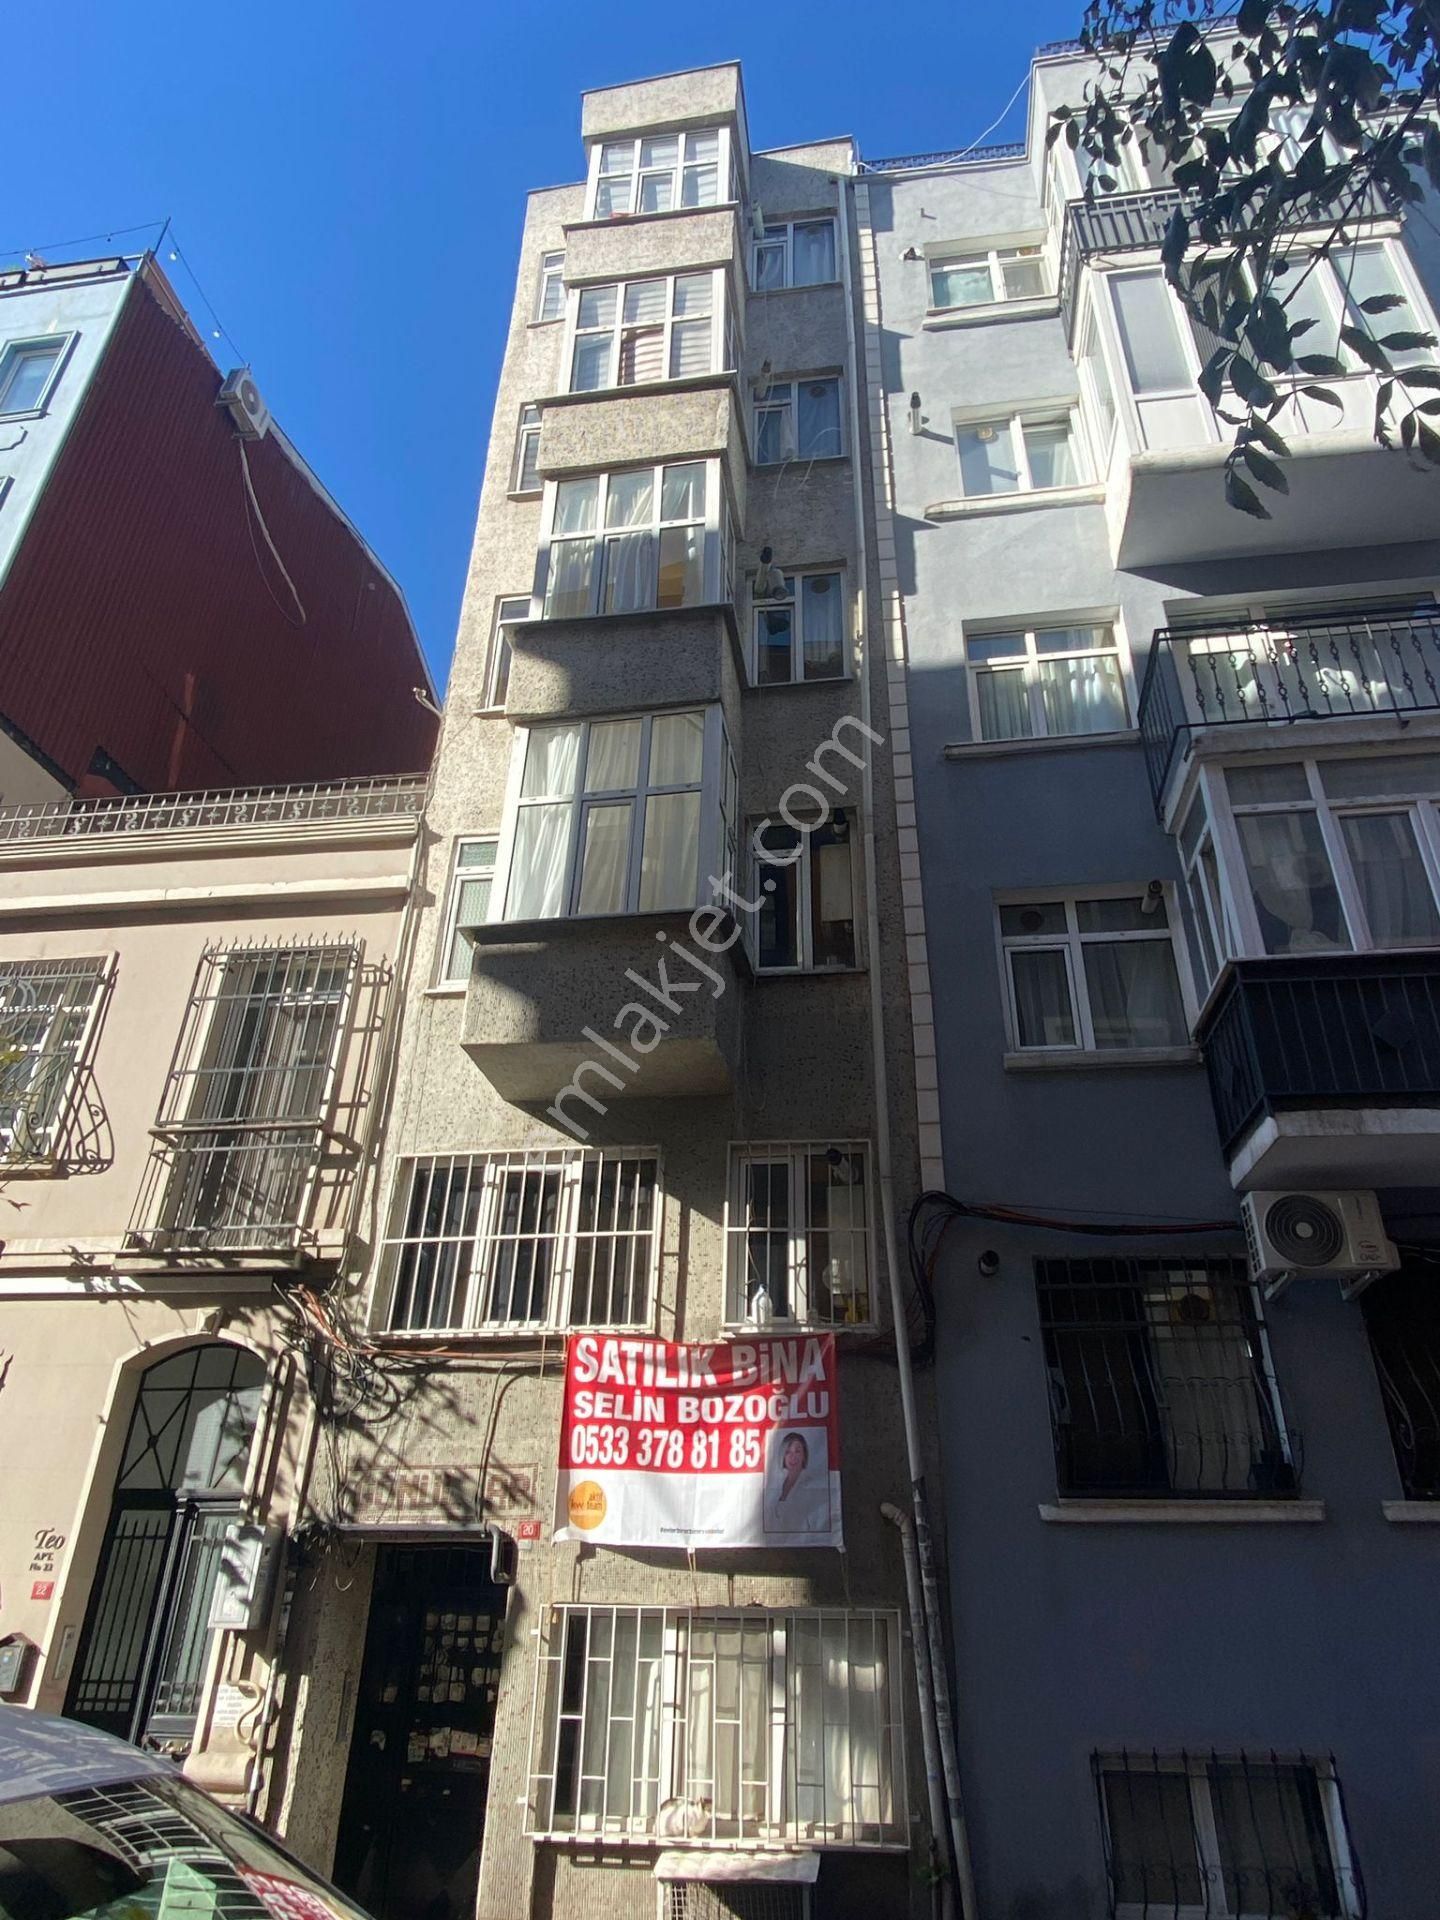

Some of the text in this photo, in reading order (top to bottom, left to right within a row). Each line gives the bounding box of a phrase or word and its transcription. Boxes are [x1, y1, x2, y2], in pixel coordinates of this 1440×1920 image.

[574, 1336, 718, 1388] SATILIK
[573, 1387, 829, 1424] SELİN BOZOĞLU
[571, 1424, 761, 1469] 0533 378 81 85
[34, 1527, 66, 1549] Teo
[523, 1525, 534, 1536] 20
